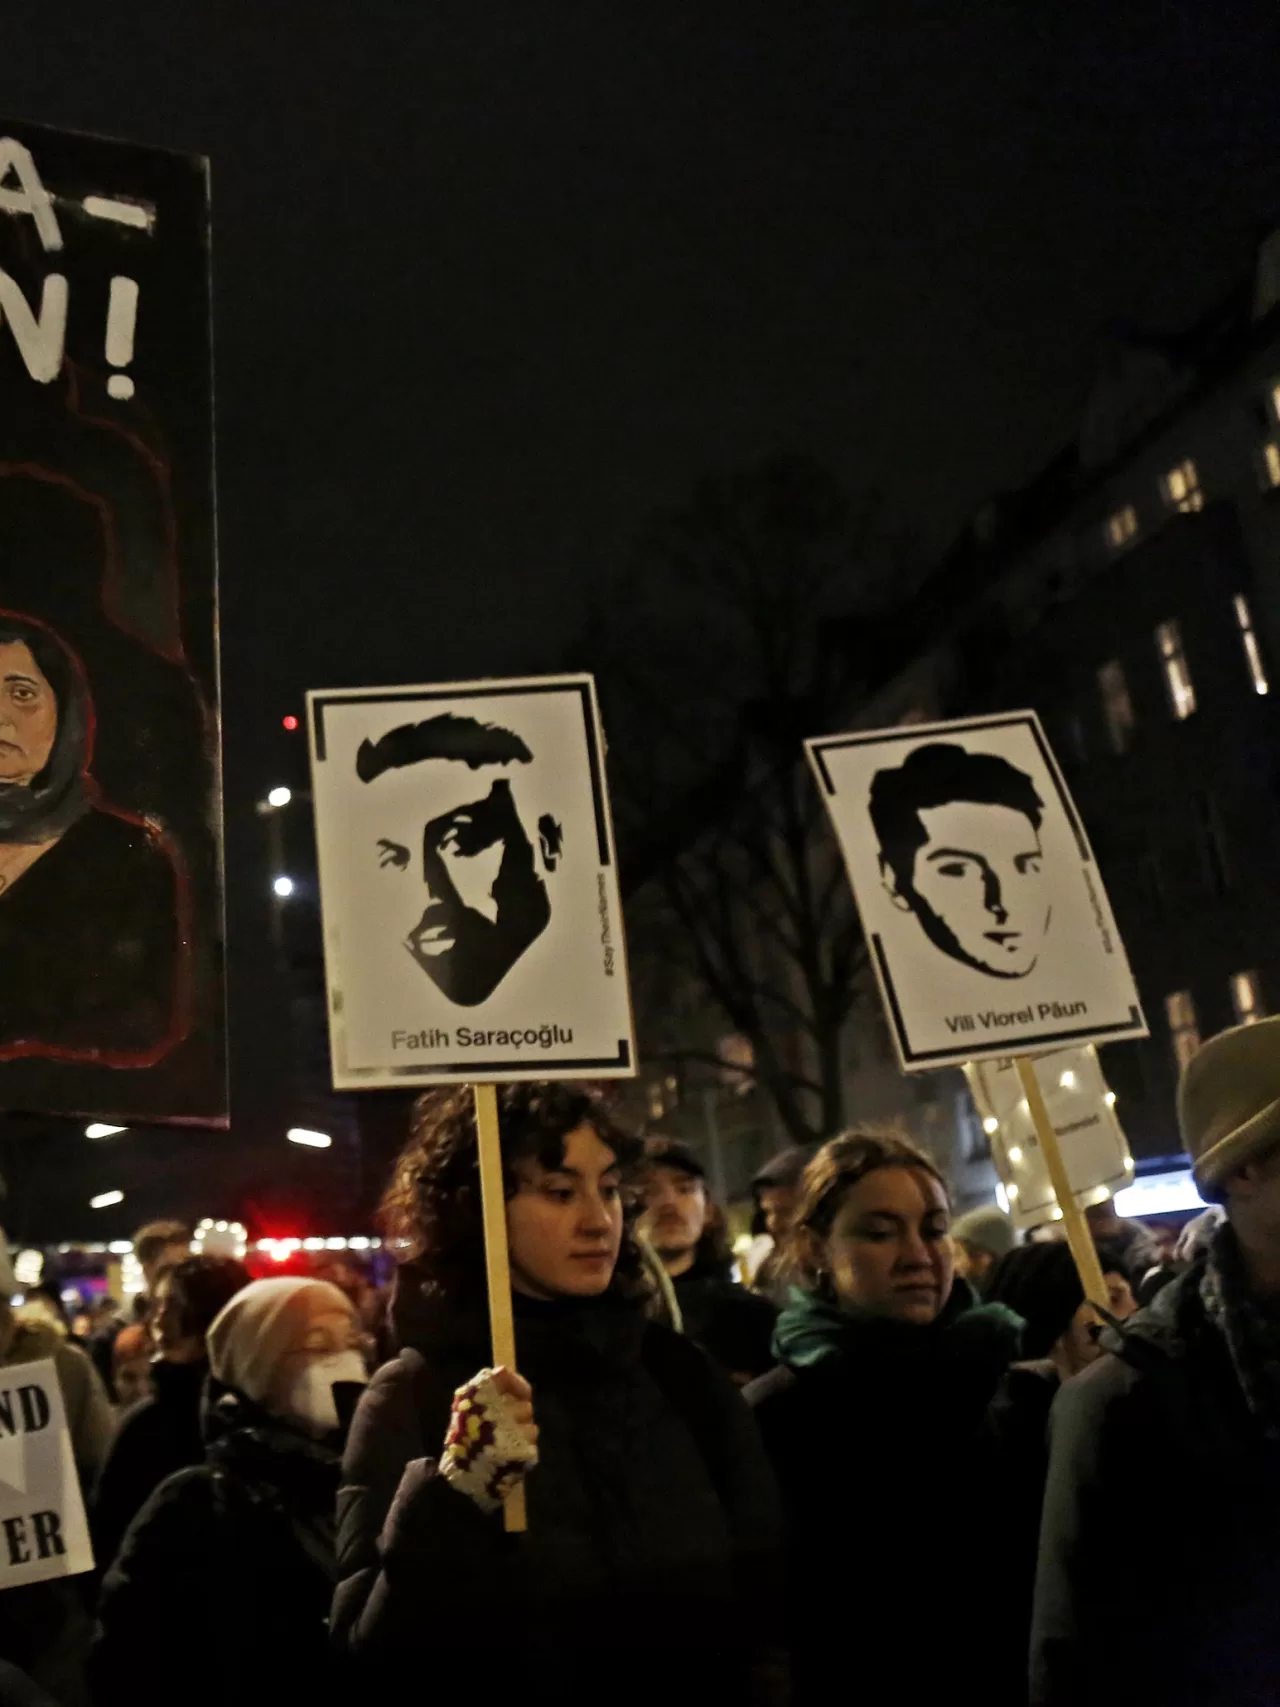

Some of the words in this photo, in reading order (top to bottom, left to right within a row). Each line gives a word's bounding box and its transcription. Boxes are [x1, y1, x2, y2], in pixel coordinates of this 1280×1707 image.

[978, 1005, 1034, 1029] Viorel
[392, 1029, 449, 1050] Fatih
[456, 1025, 573, 1048] Saraçoğlu
